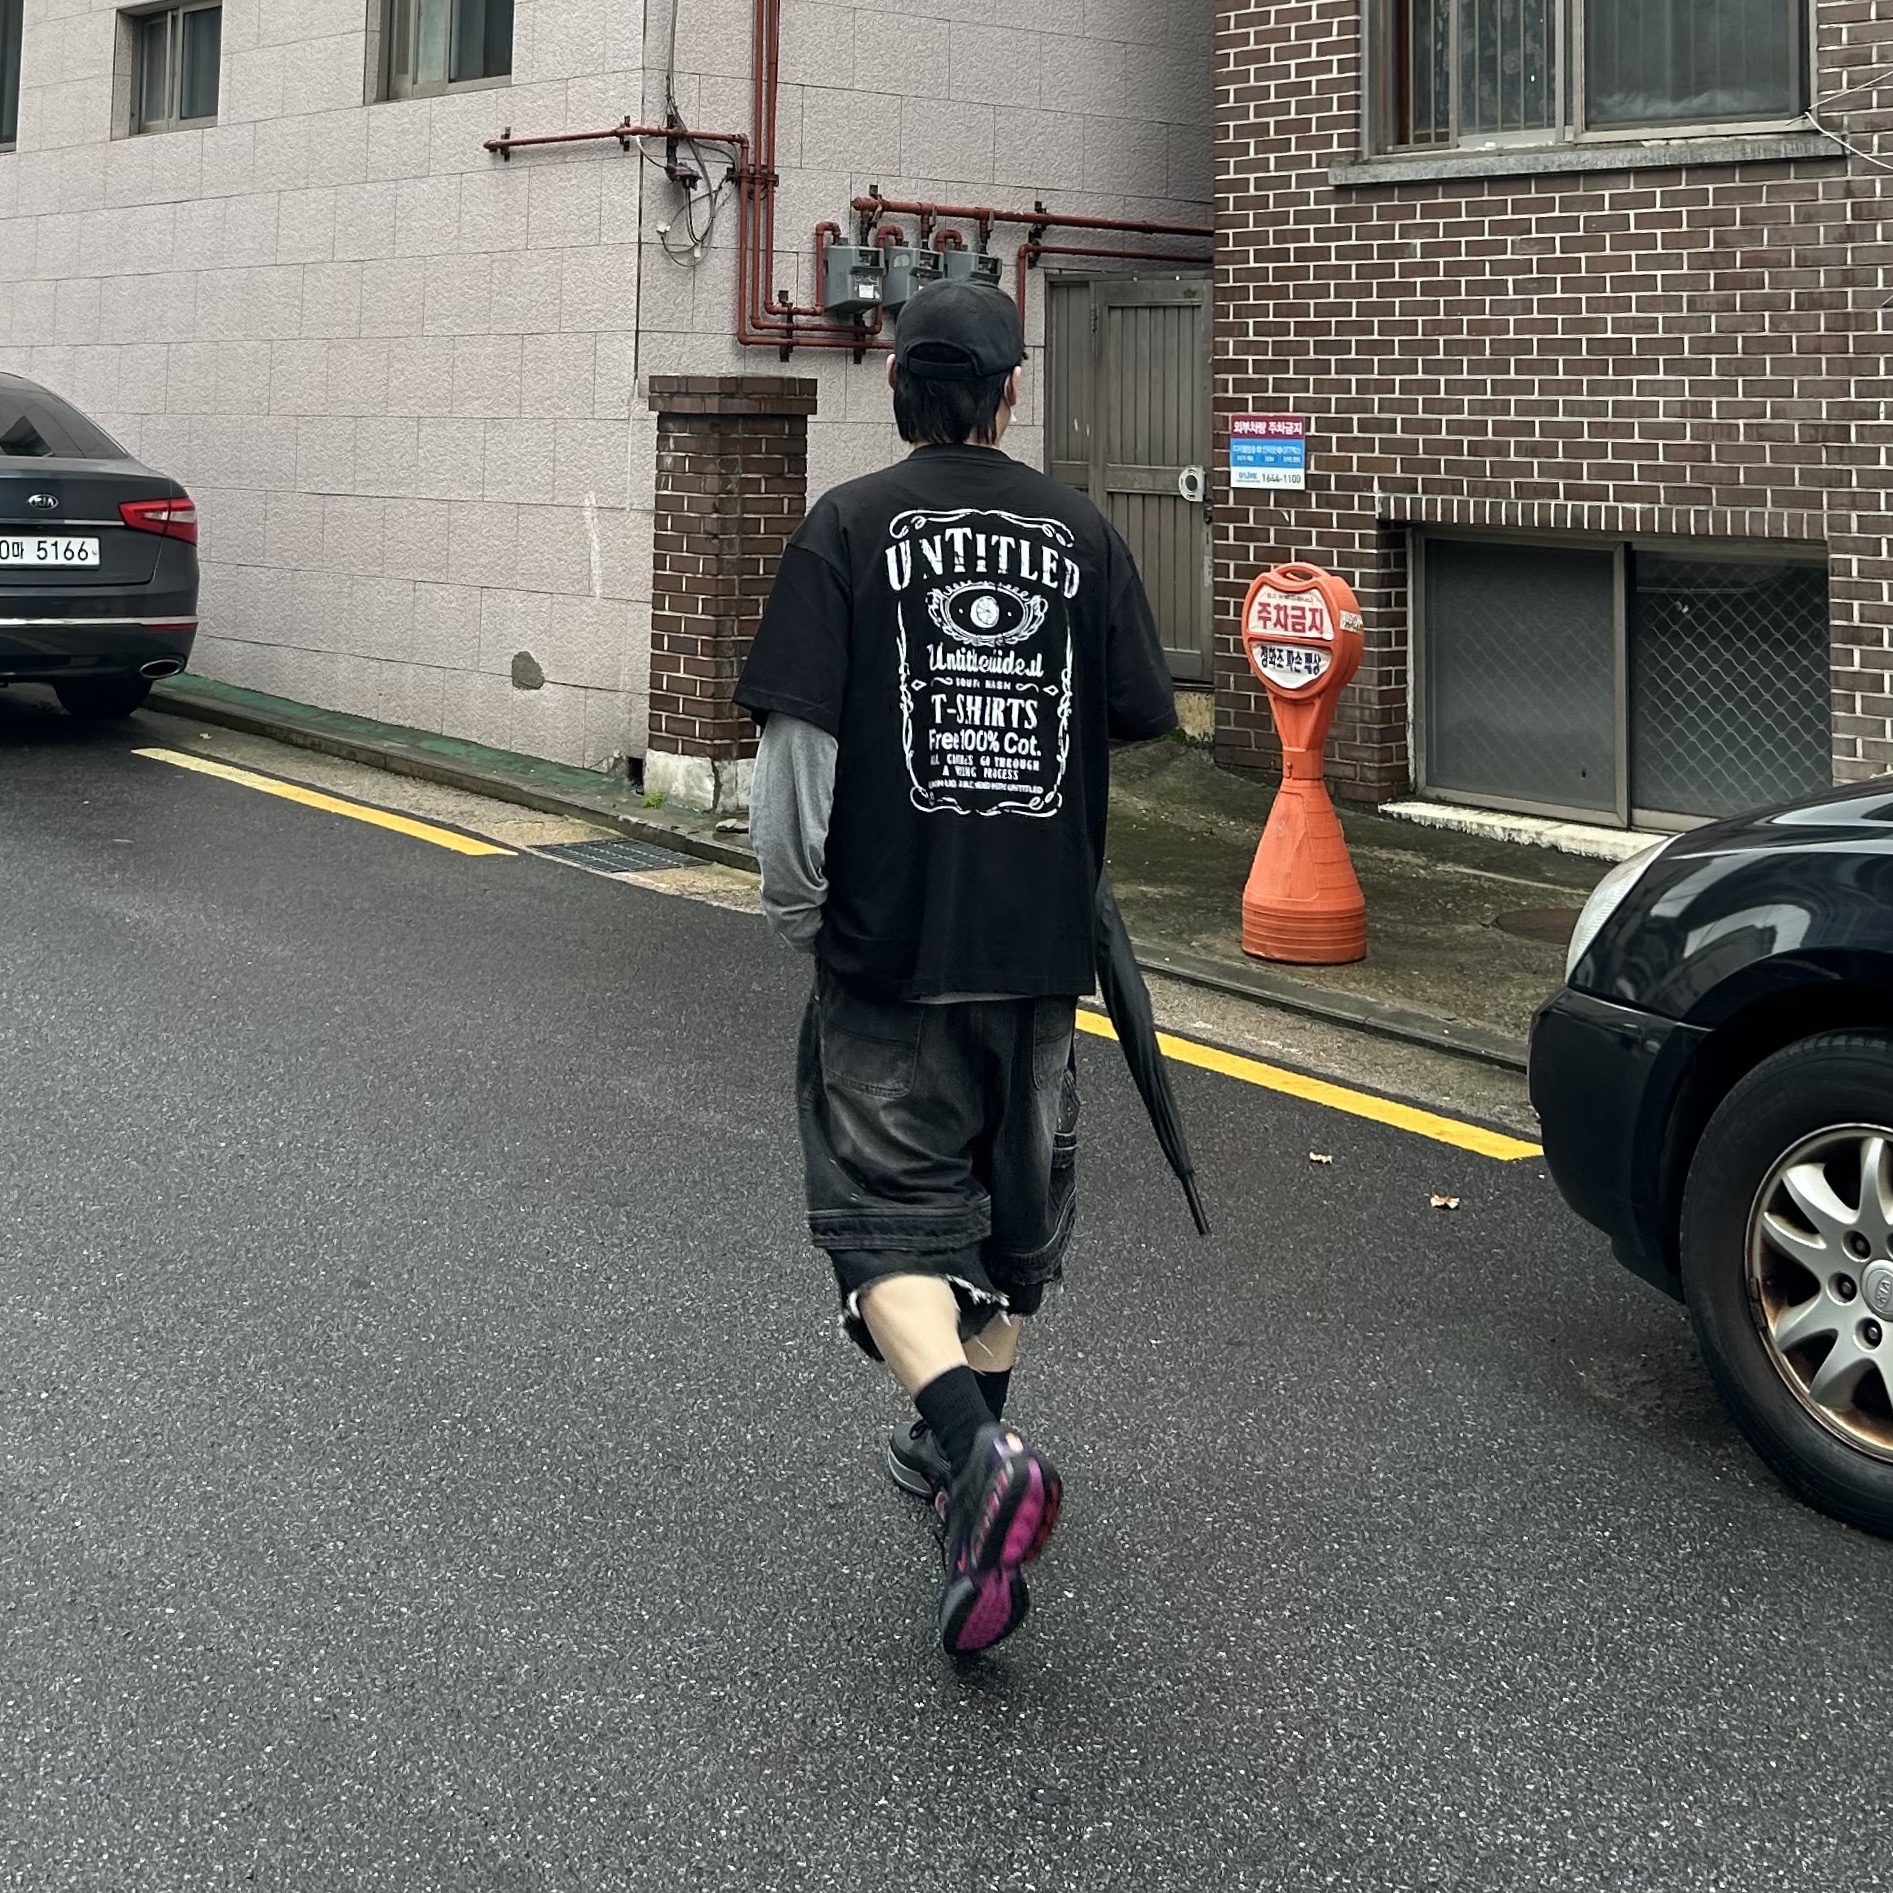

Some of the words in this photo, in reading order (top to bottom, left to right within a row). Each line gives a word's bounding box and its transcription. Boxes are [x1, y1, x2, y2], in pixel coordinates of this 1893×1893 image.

[1268, 421, 1302, 435] 주차금지
[1262, 473, 1301, 484] 1644-1100
[36, 540, 88, 561] 5166
[885, 527, 1080, 599] UNTITLED
[1257, 601, 1324, 635] 주차금지
[931, 694, 1038, 729] T-SHIRTS
[1004, 732, 1042, 756] Cot.
[983, 767, 1019, 780] PROCESS
[994, 756, 1040, 771] THROUGH
